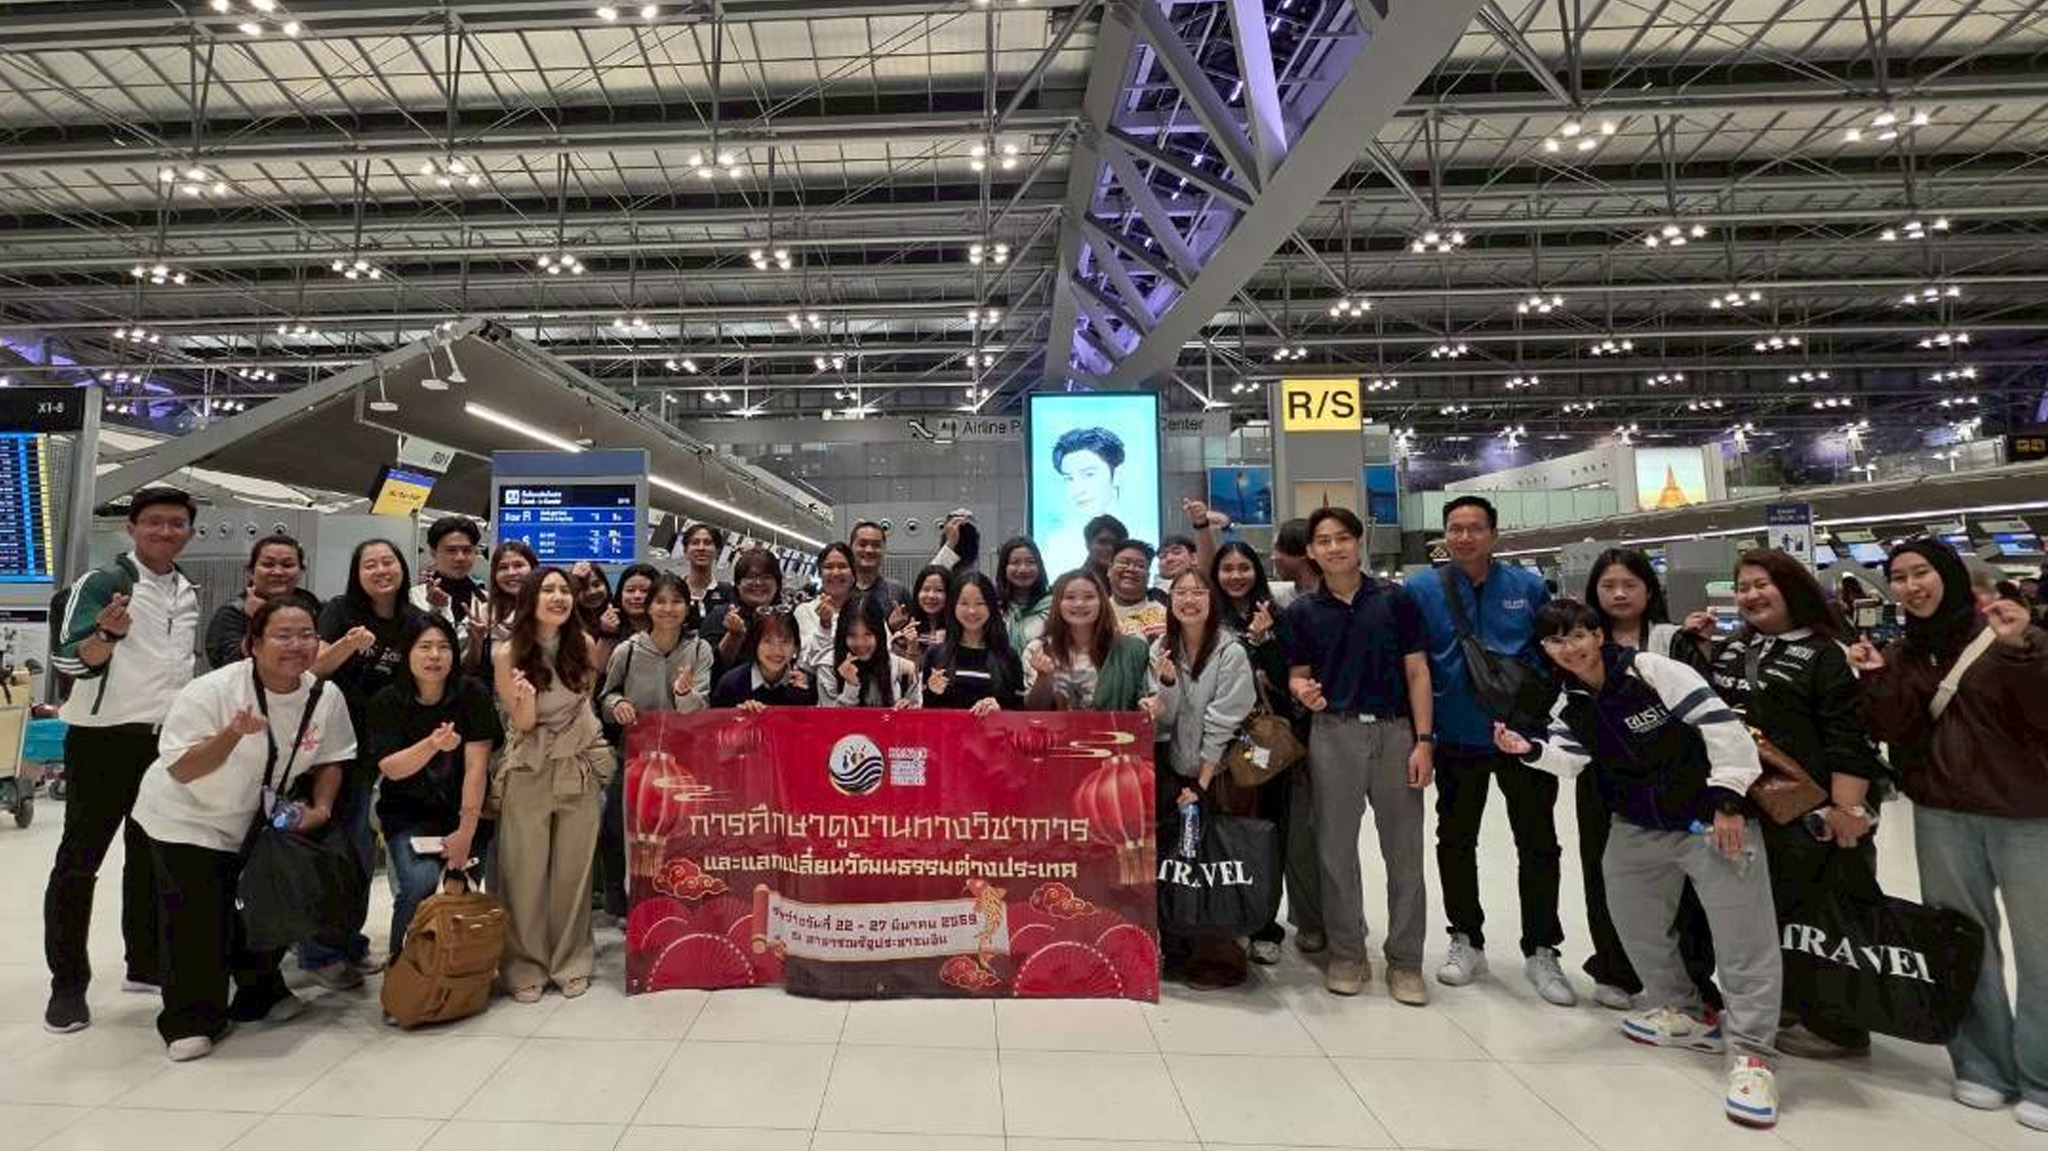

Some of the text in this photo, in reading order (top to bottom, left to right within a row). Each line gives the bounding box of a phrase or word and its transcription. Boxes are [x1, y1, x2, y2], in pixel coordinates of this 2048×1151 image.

[1288, 391, 1354, 419] R/S
[962, 419, 1006, 435] Airline
[689, 802, 1089, 848] การศึกษาดูงานทางวิชาการ
[704, 846, 1078, 879] และแลกเปลี่ยนวัฒนธรรมต่างประเทศ
[835, 919, 854, 932] 22
[869, 920, 888, 932] 27
[891, 917, 938, 932] มีนาคม
